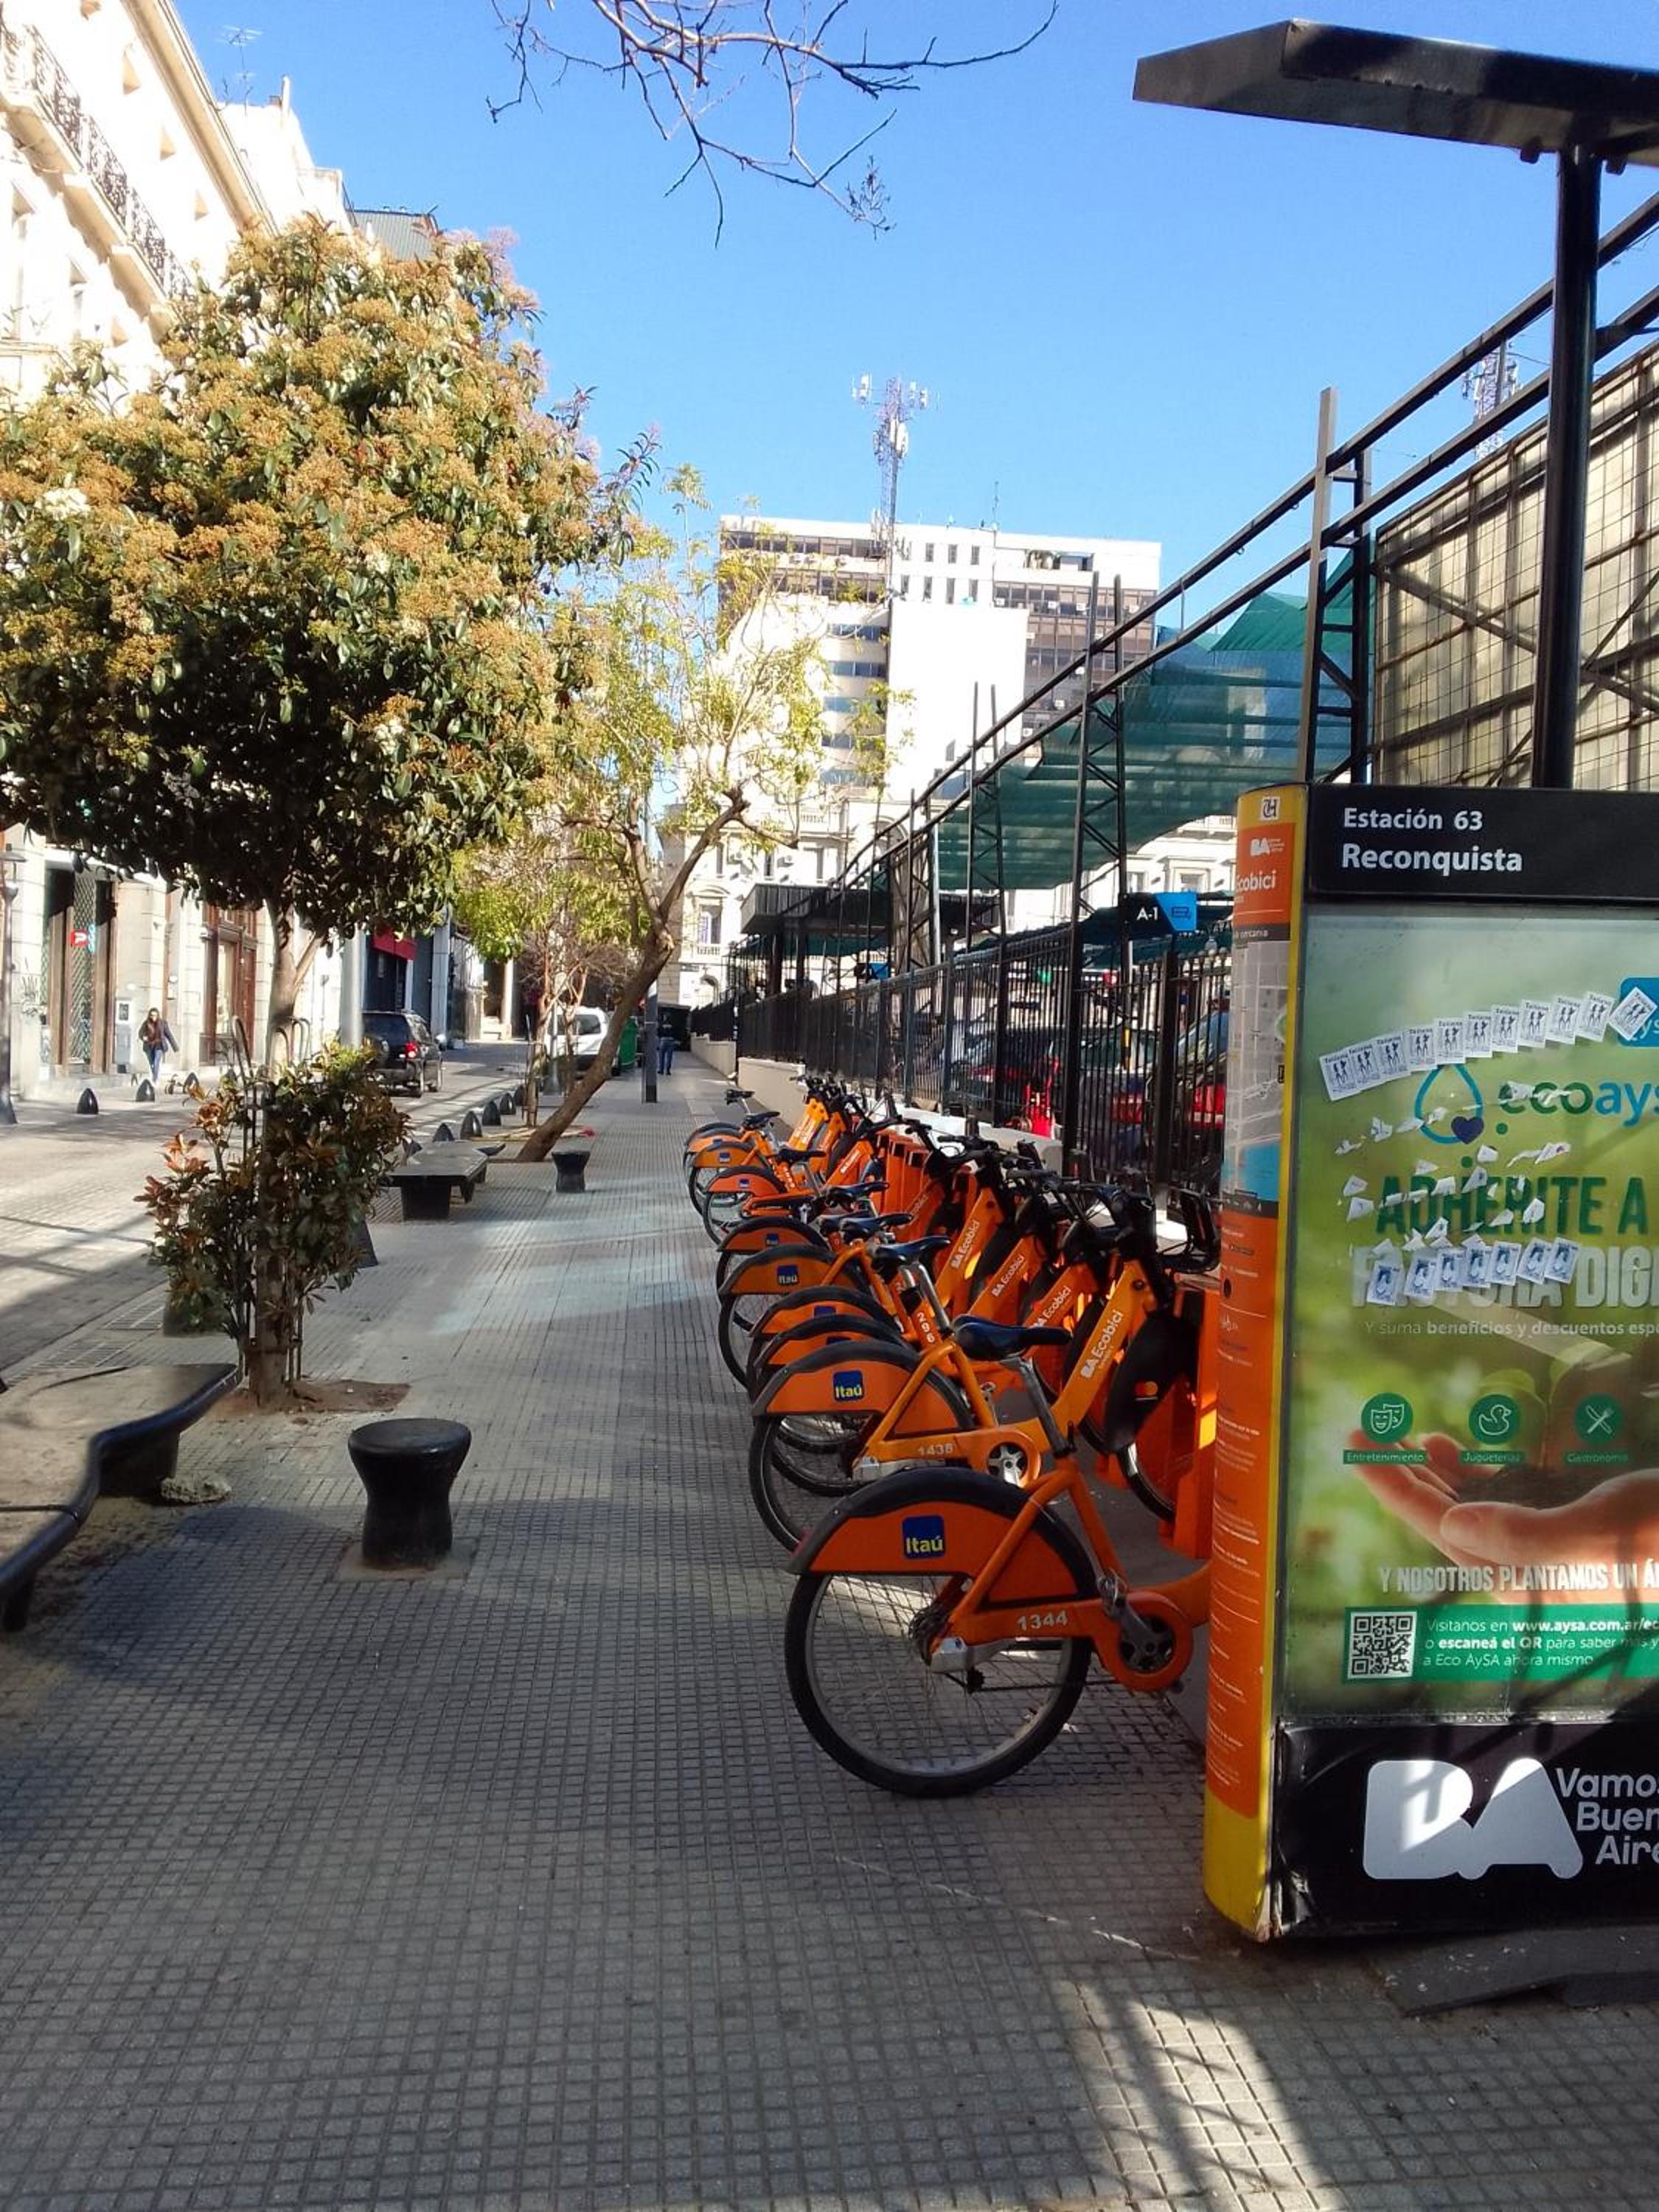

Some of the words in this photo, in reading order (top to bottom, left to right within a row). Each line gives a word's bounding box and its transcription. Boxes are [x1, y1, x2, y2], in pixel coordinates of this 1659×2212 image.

[1344, 807, 1442, 830] Estación
[1454, 810, 1483, 830] 63
[1342, 843, 1523, 877] Reconquista
[1136, 906, 1158, 921] A-1
[1498, 1082, 1659, 1127] ecoay
[1618, 1177, 1649, 1234] A
[1091, 1309, 1124, 1357] Ecobici
[1380, 1324, 1421, 1333] suma
[1427, 1321, 1512, 1334] beneficios
[1517, 1324, 1526, 1338] y
[1531, 1321, 1624, 1335] descuentos
[835, 1384, 863, 1399] Itaú
[905, 1535, 944, 1554] Itaú
[1380, 1568, 1393, 1593] Y
[1397, 1566, 1493, 1593] NOSOTROS
[1499, 1564, 1608, 1591] PLANTAMOS
[1613, 1562, 1638, 1590] UN
[1643, 1557, 1659, 1589] Á
[1017, 1610, 1068, 1631] 1344
[1428, 1618, 1486, 1632] Visitanos
[1490, 1621, 1509, 1632] en
[1439, 1636, 1498, 1649] escaneá
[1501, 1636, 1515, 1649] el
[1519, 1637, 1543, 1651] QR
[1546, 1638, 1576, 1652] para
[1580, 1637, 1616, 1649] saber
[1436, 1654, 1460, 1666] Eco
[1465, 1652, 1500, 1669] AySA
[1555, 1767, 1659, 1798] Vamo
